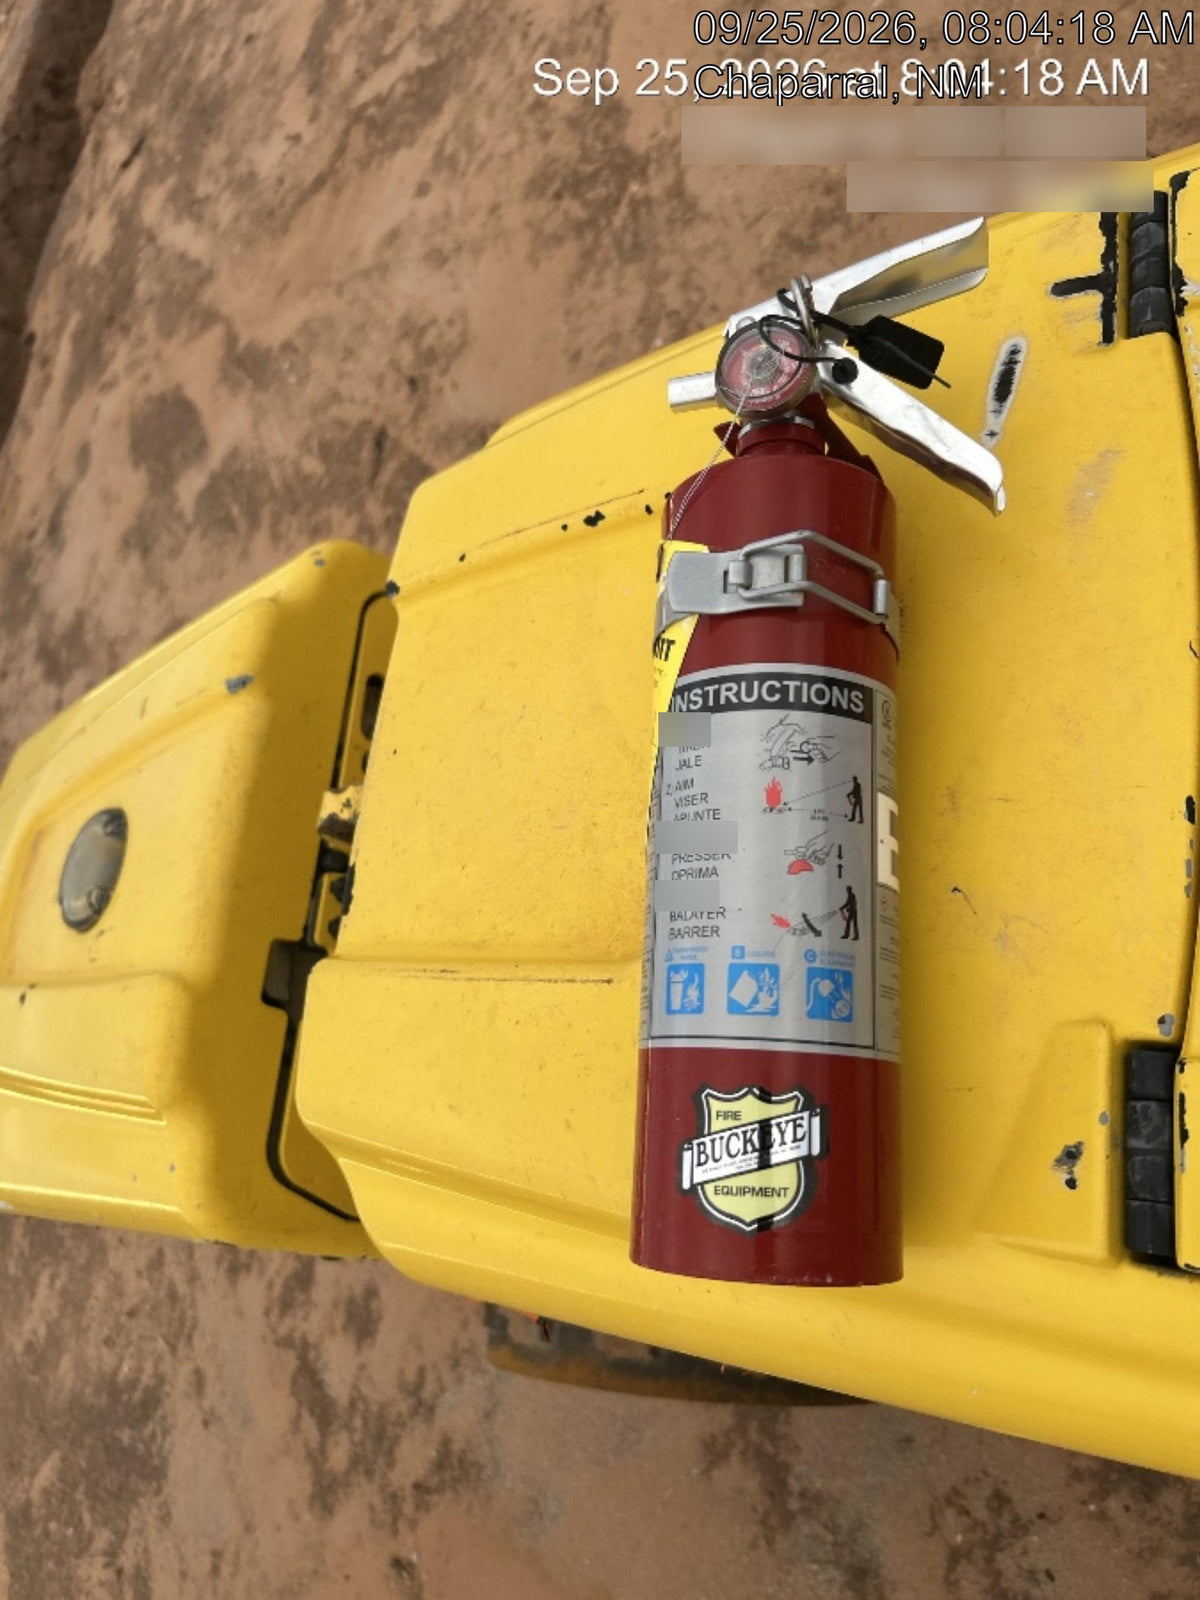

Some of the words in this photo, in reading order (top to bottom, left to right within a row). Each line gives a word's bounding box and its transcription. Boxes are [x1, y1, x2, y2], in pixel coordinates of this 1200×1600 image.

[671, 680, 865, 713] INSTRUCTIONS
[675, 755, 703, 771] JALE
[674, 793, 709, 808] VISER
[668, 925, 721, 941] BARRER
[715, 1110, 742, 1121] FIRE
[695, 1115, 808, 1168] BUCKEYE
[713, 1184, 790, 1198] EQUIPMENT
